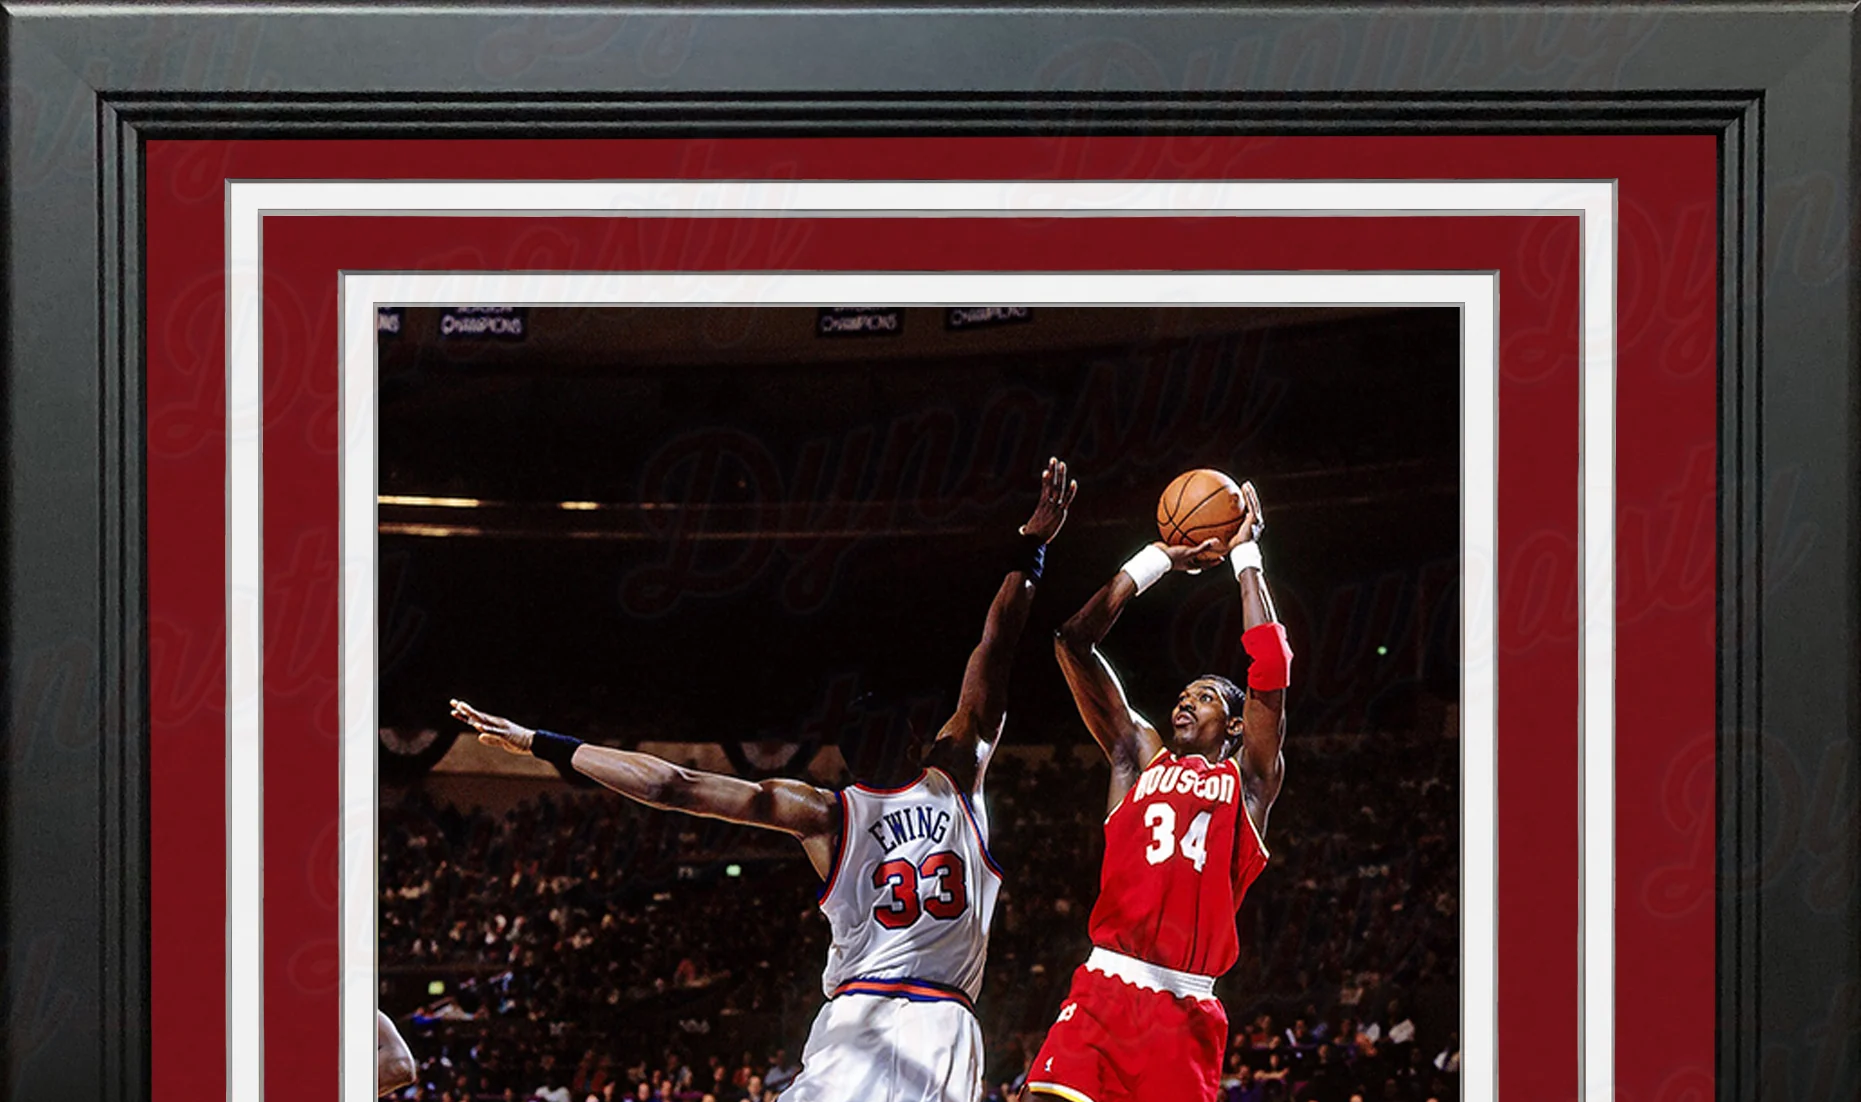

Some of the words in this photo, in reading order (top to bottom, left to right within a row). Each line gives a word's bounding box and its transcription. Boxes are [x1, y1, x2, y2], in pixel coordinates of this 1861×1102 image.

[868, 806, 950, 854] EWING
[1144, 802, 1212, 873] 34
[872, 850, 968, 930] 33
